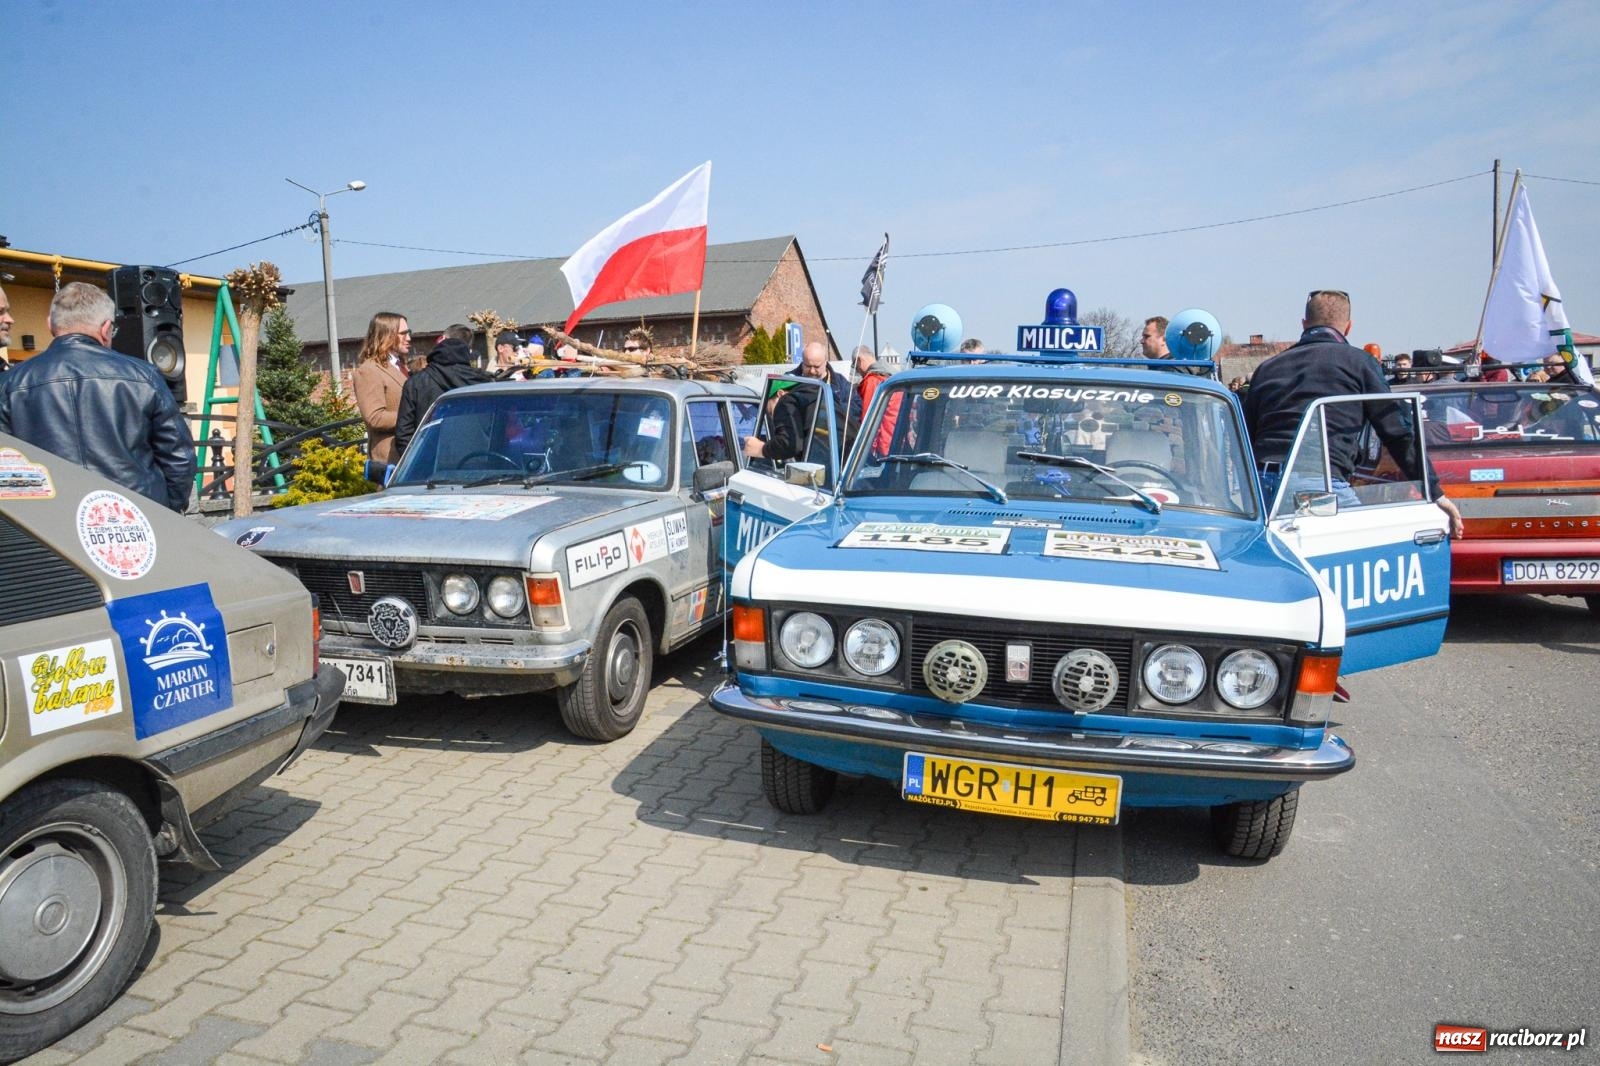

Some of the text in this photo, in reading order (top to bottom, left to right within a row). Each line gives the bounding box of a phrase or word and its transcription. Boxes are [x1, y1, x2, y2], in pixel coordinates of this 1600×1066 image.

[1022, 328, 1098, 350] MILICJA
[949, 385, 1003, 399] WGR
[1007, 385, 1155, 404] Klasycznie
[90, 532, 147, 545] DO POLSKI
[859, 534, 990, 547] 1185
[575, 545, 622, 573] FILIPPO
[1053, 543, 1206, 561] 2449
[1514, 562, 1600, 580] DOA 8299
[157, 664, 208, 691] MARIAN
[345, 663, 384, 684] 7341
[153, 680, 215, 710] CZARTER
[908, 778, 921, 788] PL
[930, 761, 1055, 808] WGR H1
